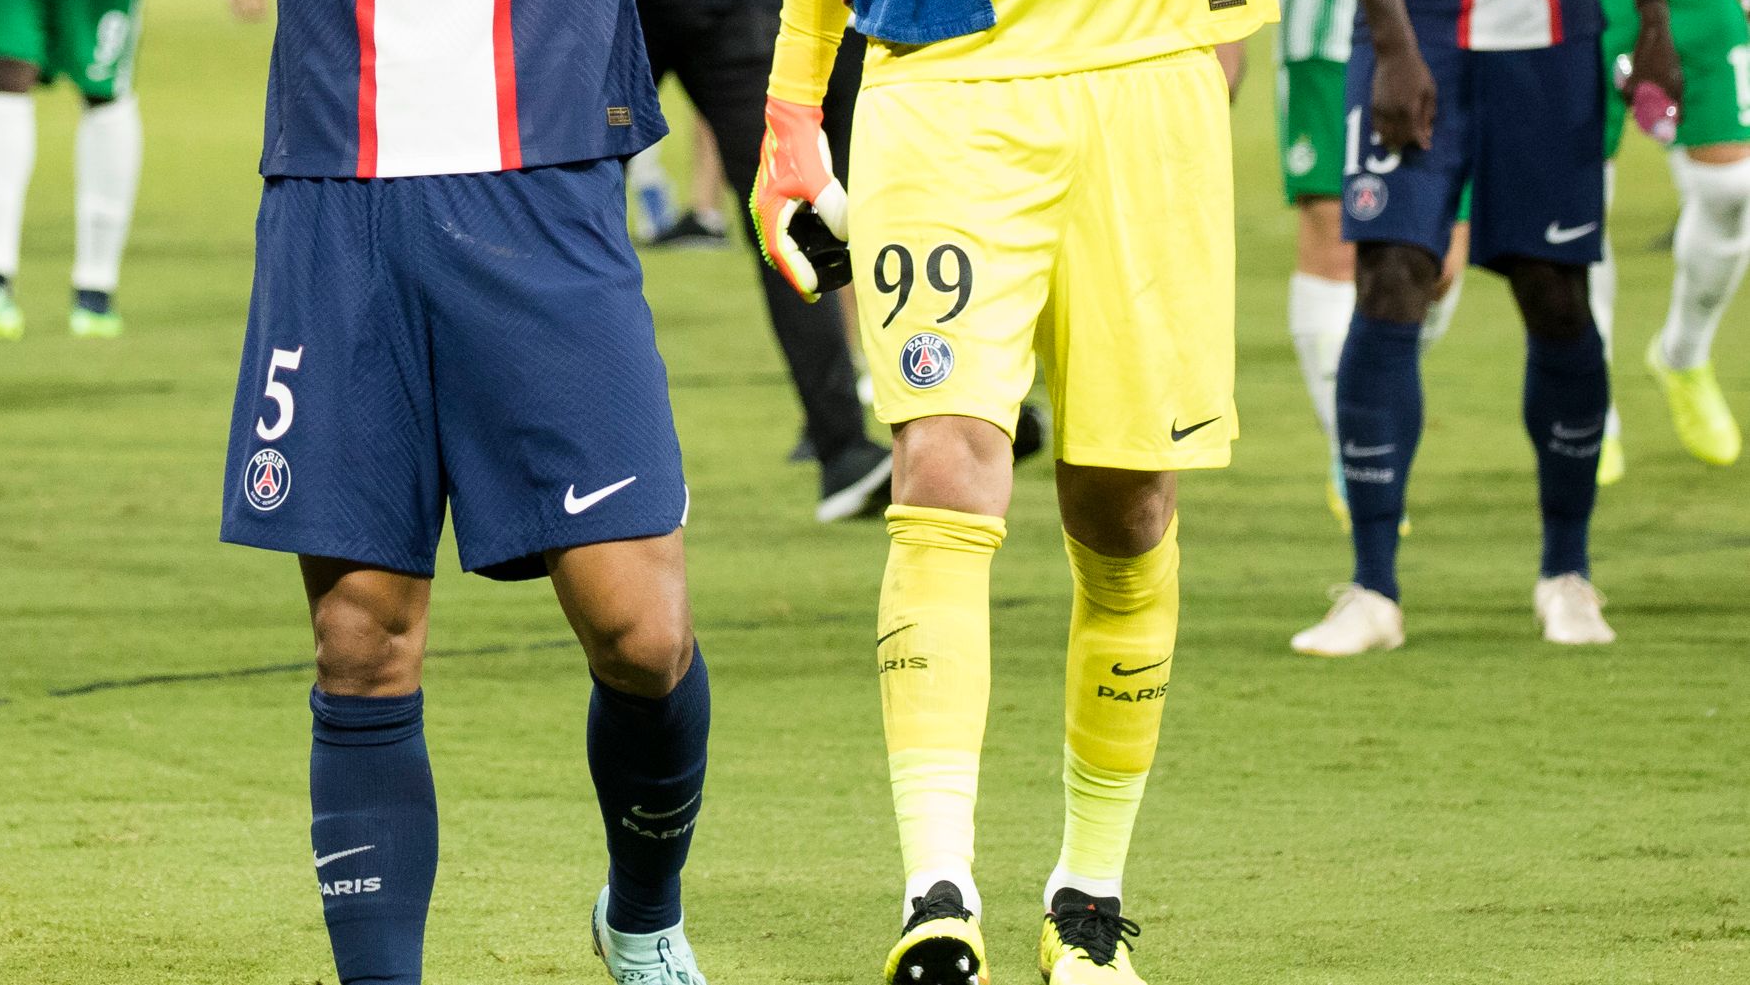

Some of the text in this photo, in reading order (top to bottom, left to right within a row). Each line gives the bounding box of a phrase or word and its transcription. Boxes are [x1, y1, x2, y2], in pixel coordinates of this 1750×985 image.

[874, 244, 973, 329] 99
[907, 336, 942, 352] PARIS
[256, 345, 304, 441] 5
[255, 452, 285, 469] PARIS
[1097, 681, 1169, 703] PARIS
